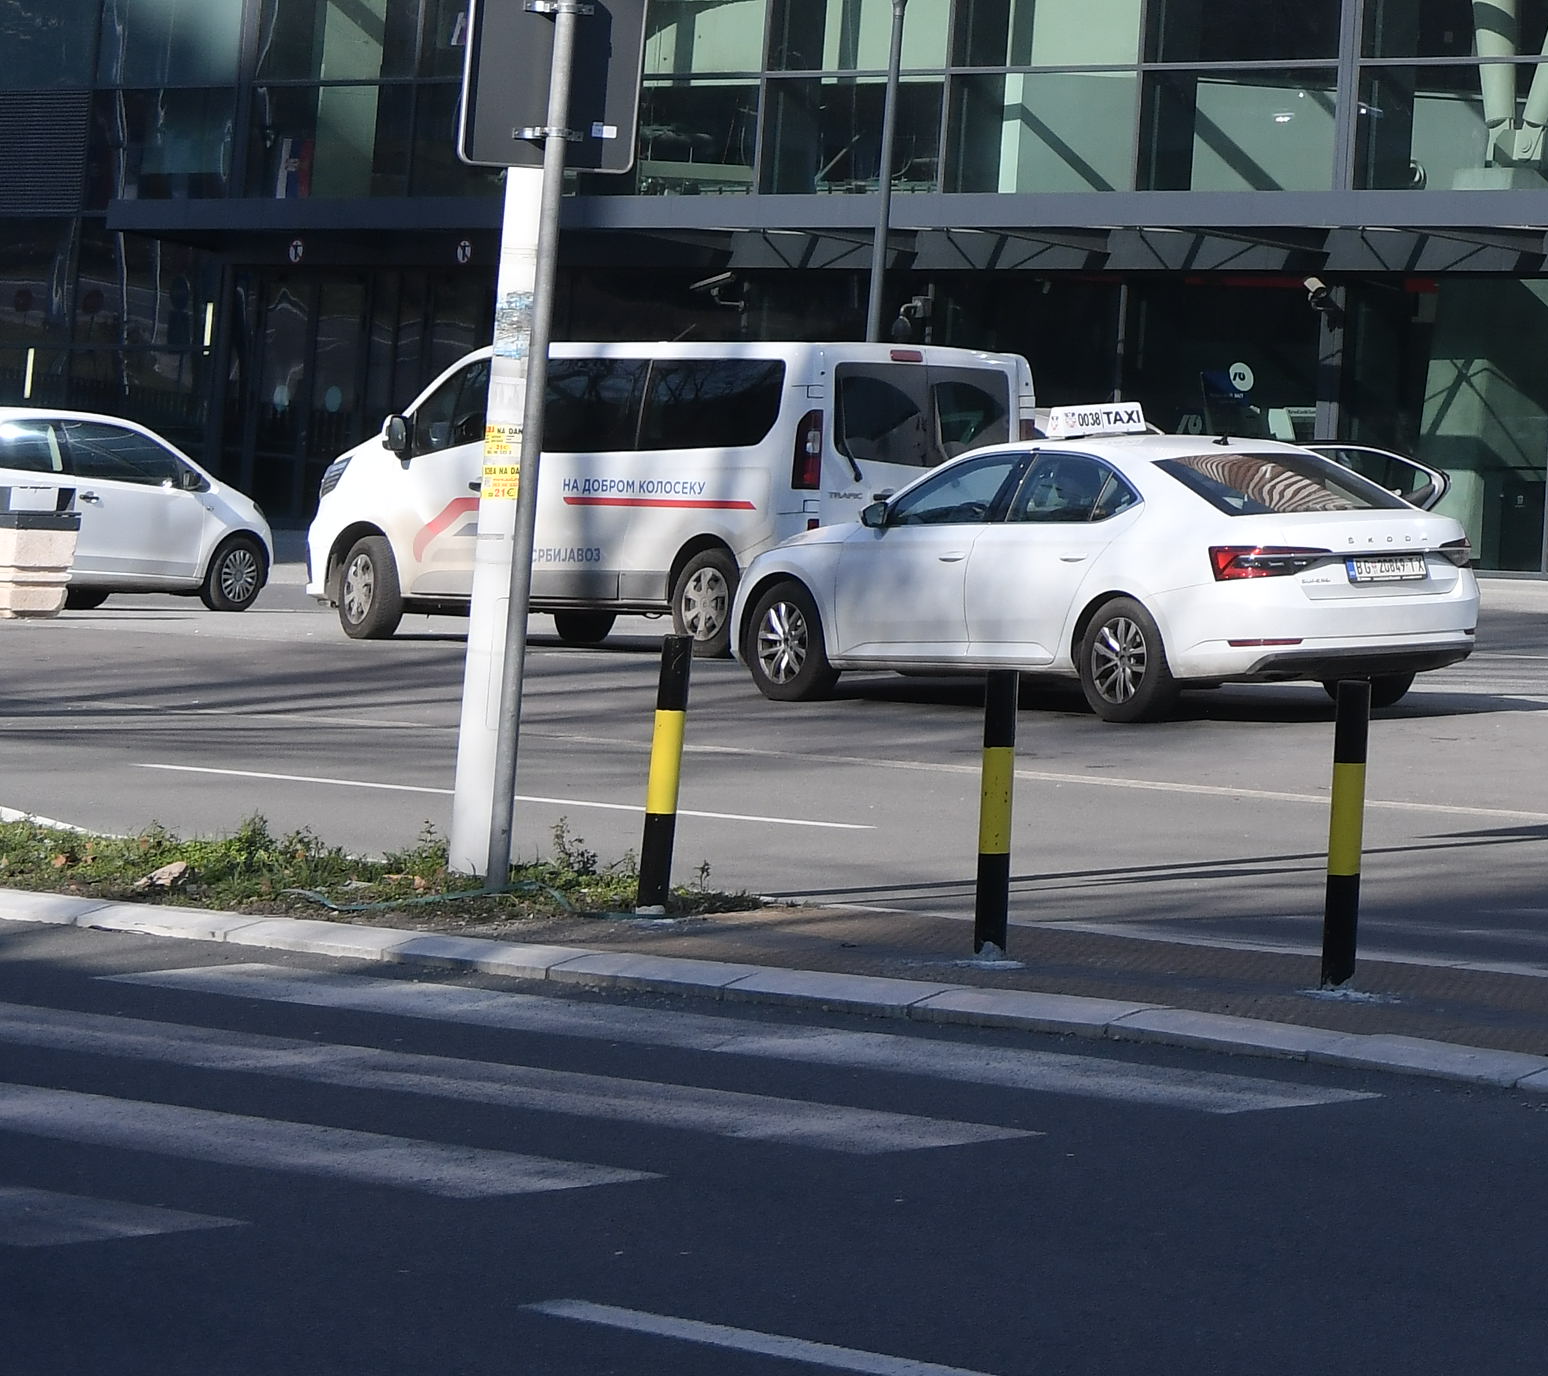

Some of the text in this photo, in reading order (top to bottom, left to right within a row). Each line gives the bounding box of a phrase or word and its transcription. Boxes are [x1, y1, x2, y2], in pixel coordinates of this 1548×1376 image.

[1078, 410, 1141, 426] 0038 TAXI
[563, 478, 706, 496] НА ДОБРОМ КОЛОСЕКУ
[532, 548, 601, 563] СРБИЈАВОЗ
[1356, 559, 1371, 575] BG
